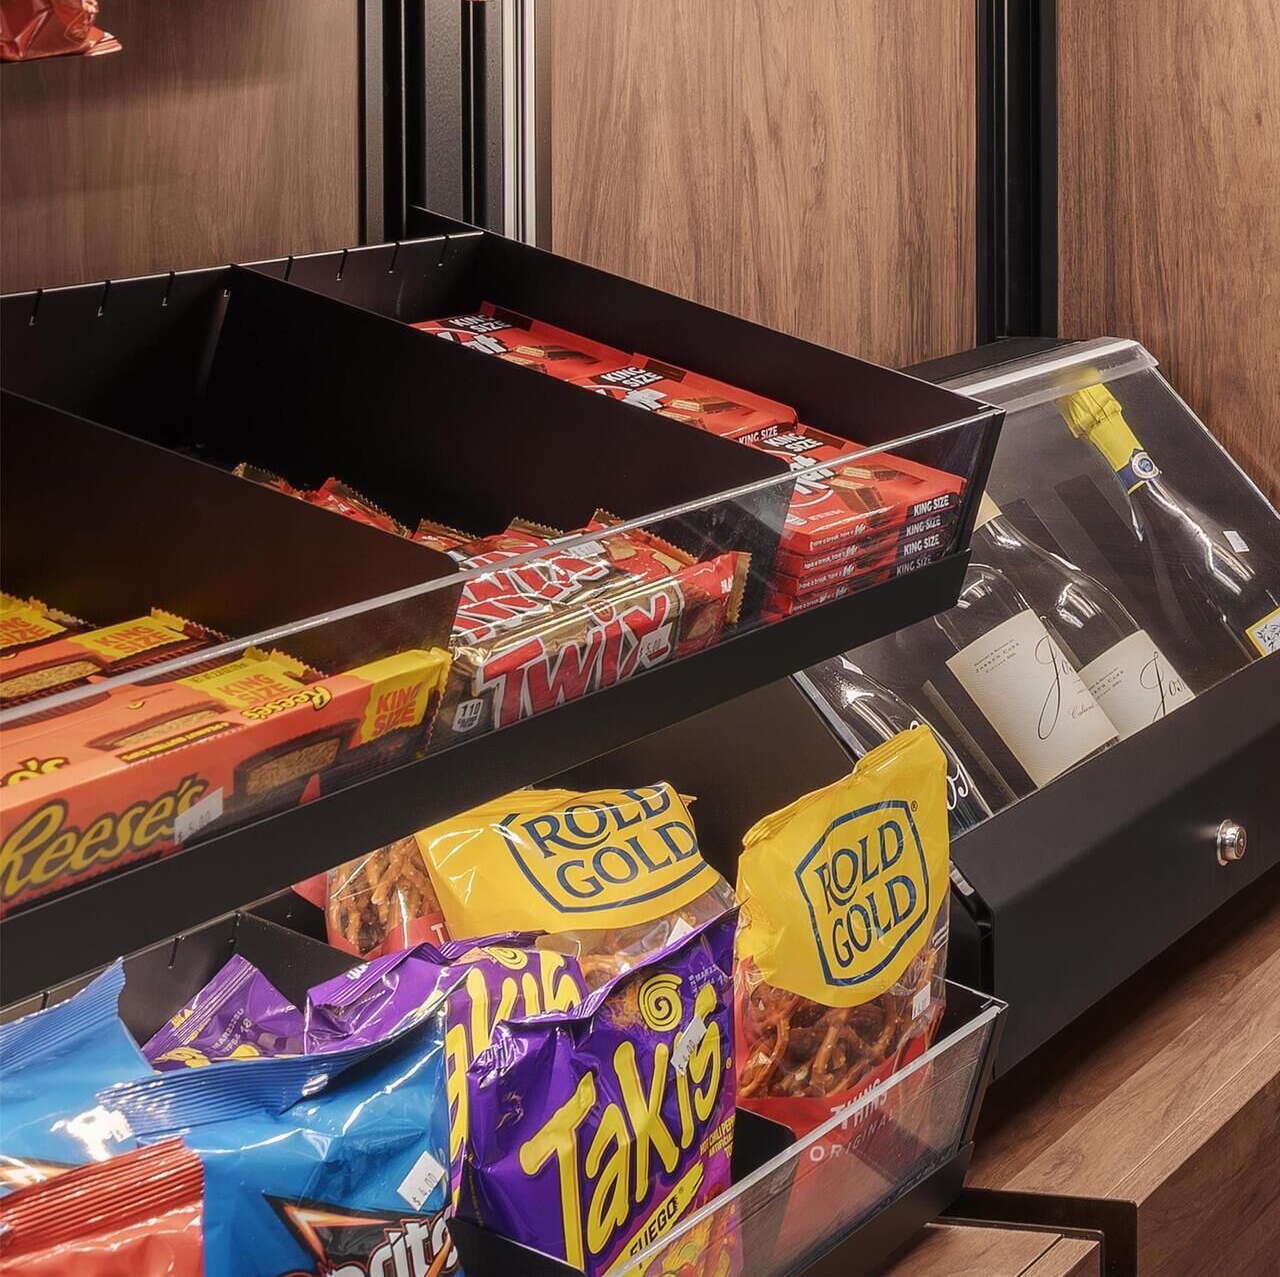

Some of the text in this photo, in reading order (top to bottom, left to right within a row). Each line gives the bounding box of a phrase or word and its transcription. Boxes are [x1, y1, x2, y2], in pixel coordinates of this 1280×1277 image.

[761, 425, 779, 440] SIZE
[913, 495, 950, 516] KING SIZE
[556, 825, 700, 899] GOLD
[821, 821, 907, 907] ROLD
[831, 875, 914, 969] GOLD
